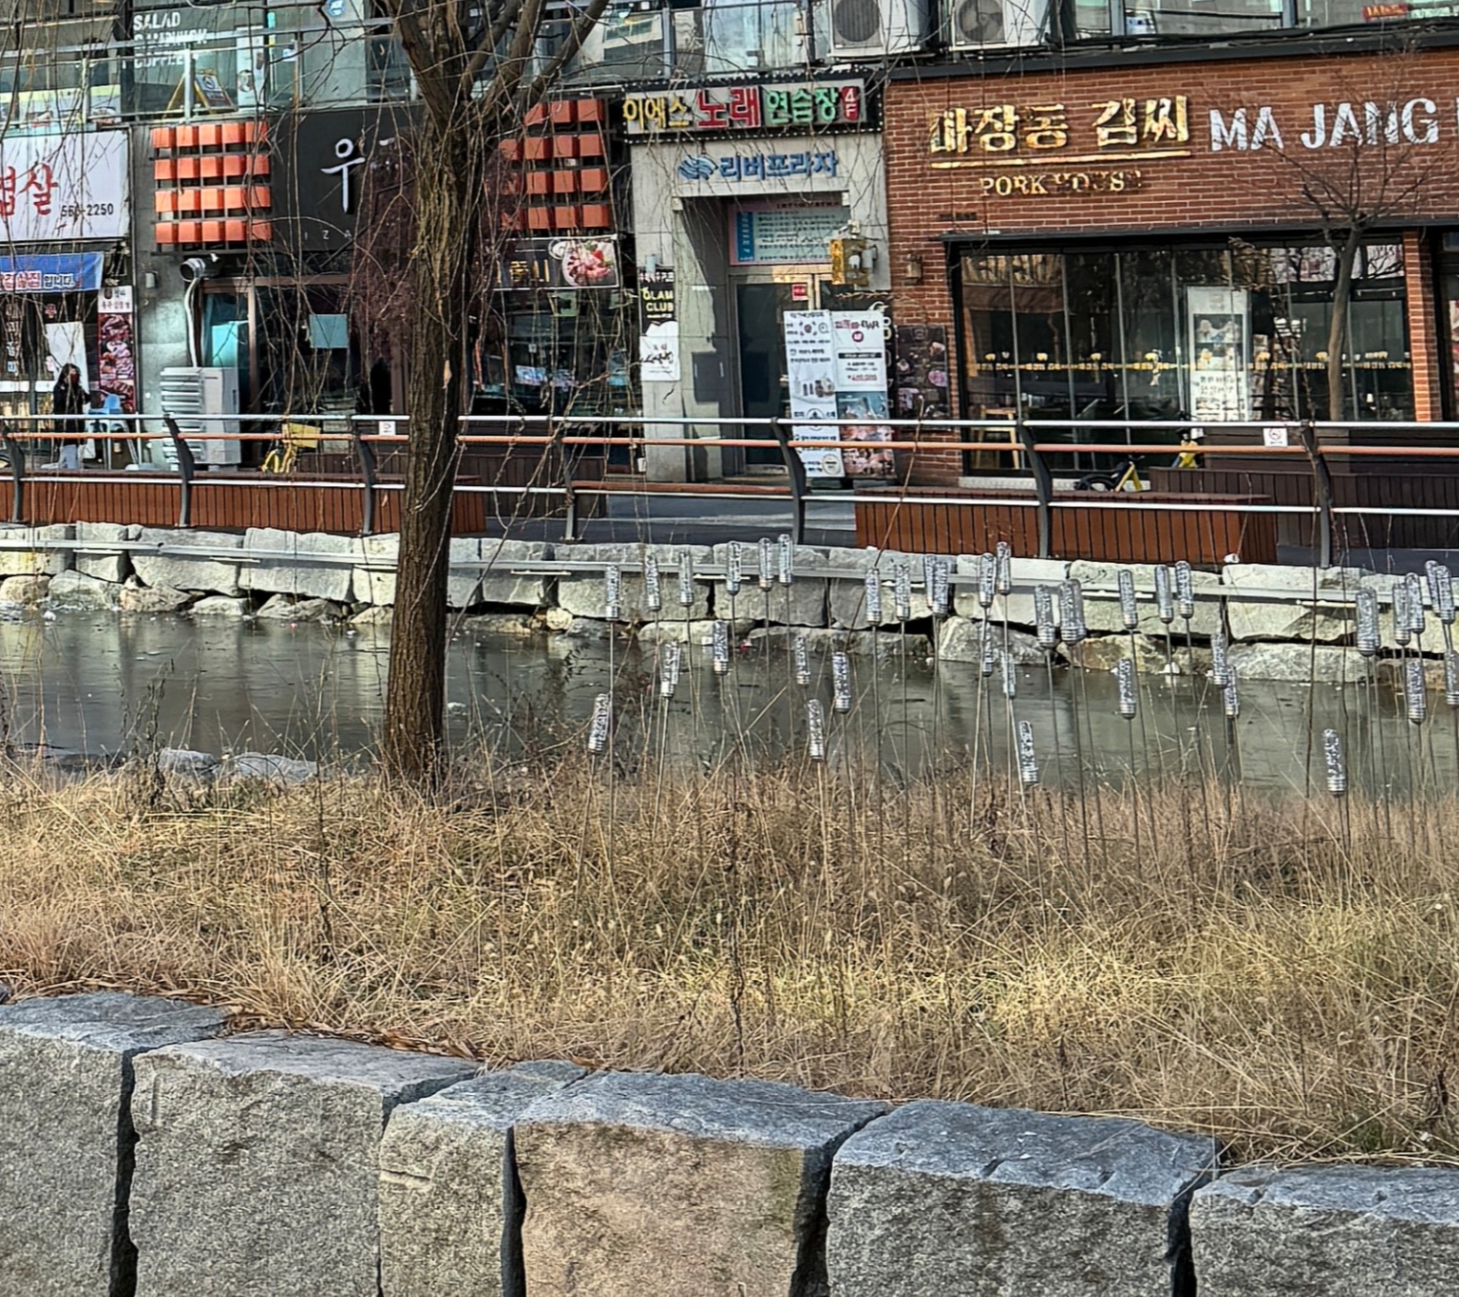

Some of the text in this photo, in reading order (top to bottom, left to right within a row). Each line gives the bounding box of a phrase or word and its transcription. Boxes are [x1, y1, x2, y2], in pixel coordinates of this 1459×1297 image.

[133, 12, 181, 31] SALAD
[930, 94, 1189, 153] 마장동 김씨
[1209, 97, 1439, 151] MA JANG
[719, 150, 838, 181] 리버프라자
[979, 174, 1049, 196] PORK
